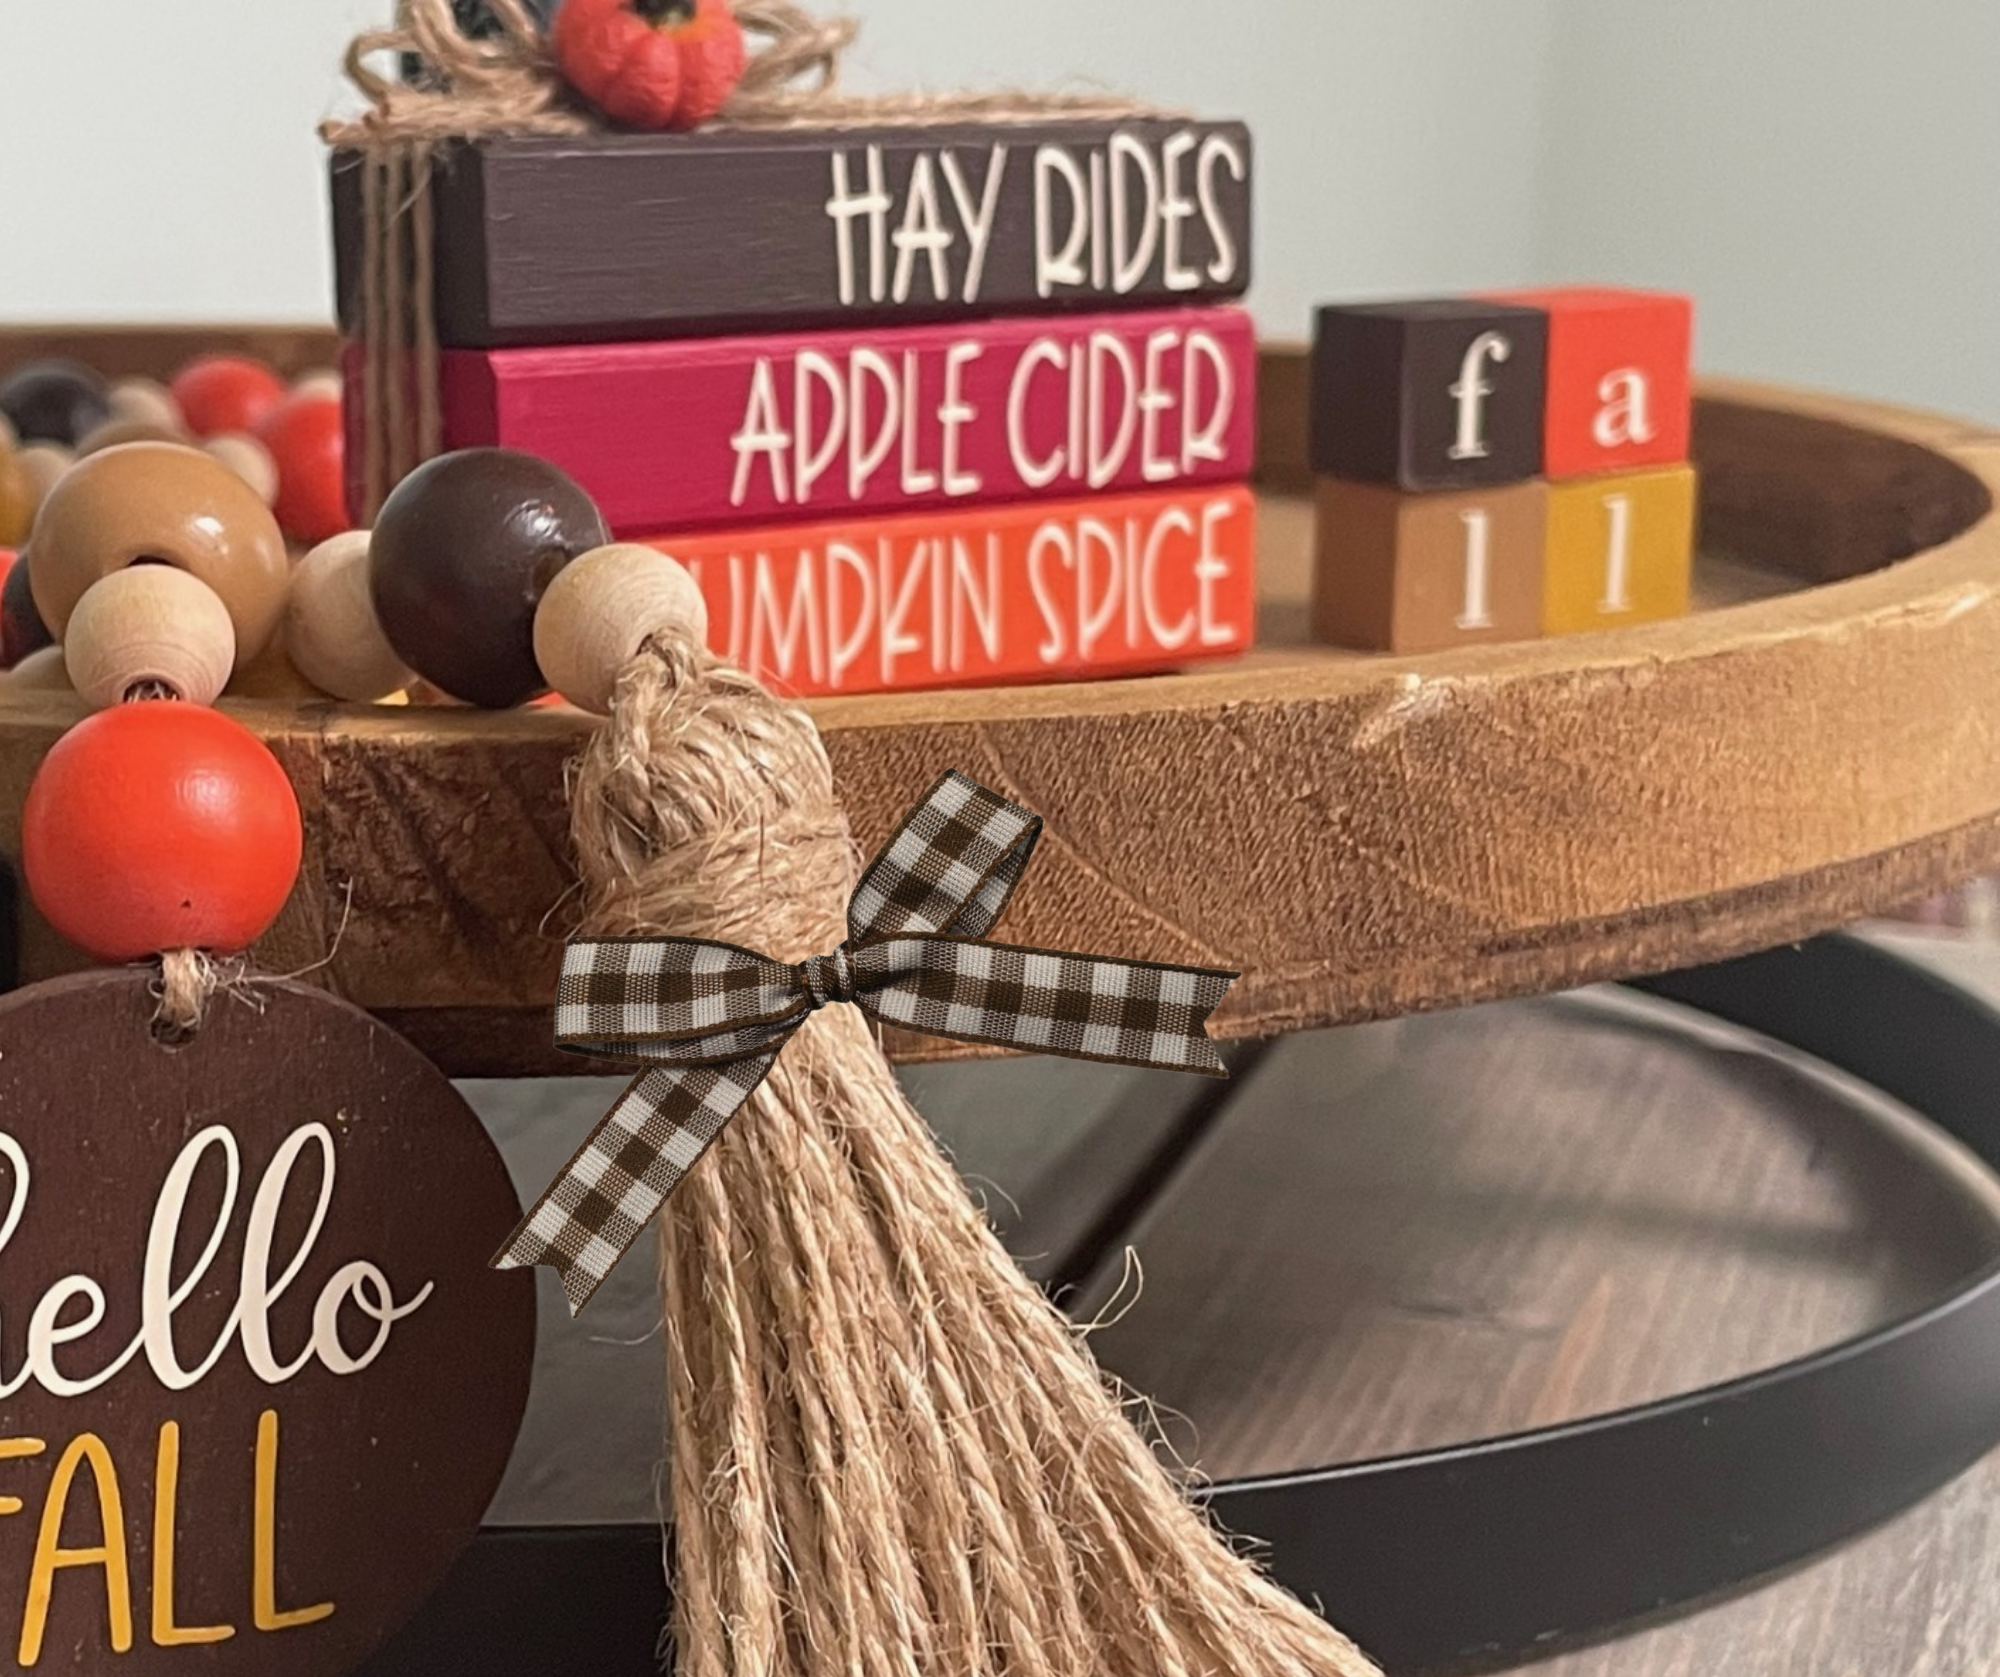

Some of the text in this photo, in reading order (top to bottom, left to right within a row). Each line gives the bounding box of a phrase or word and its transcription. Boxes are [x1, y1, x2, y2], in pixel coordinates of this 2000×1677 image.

[826, 131, 1245, 305] HAY RIDES
[730, 327, 1235, 506] APPLE CIDER
[1026, 500, 1239, 663] SPICE
